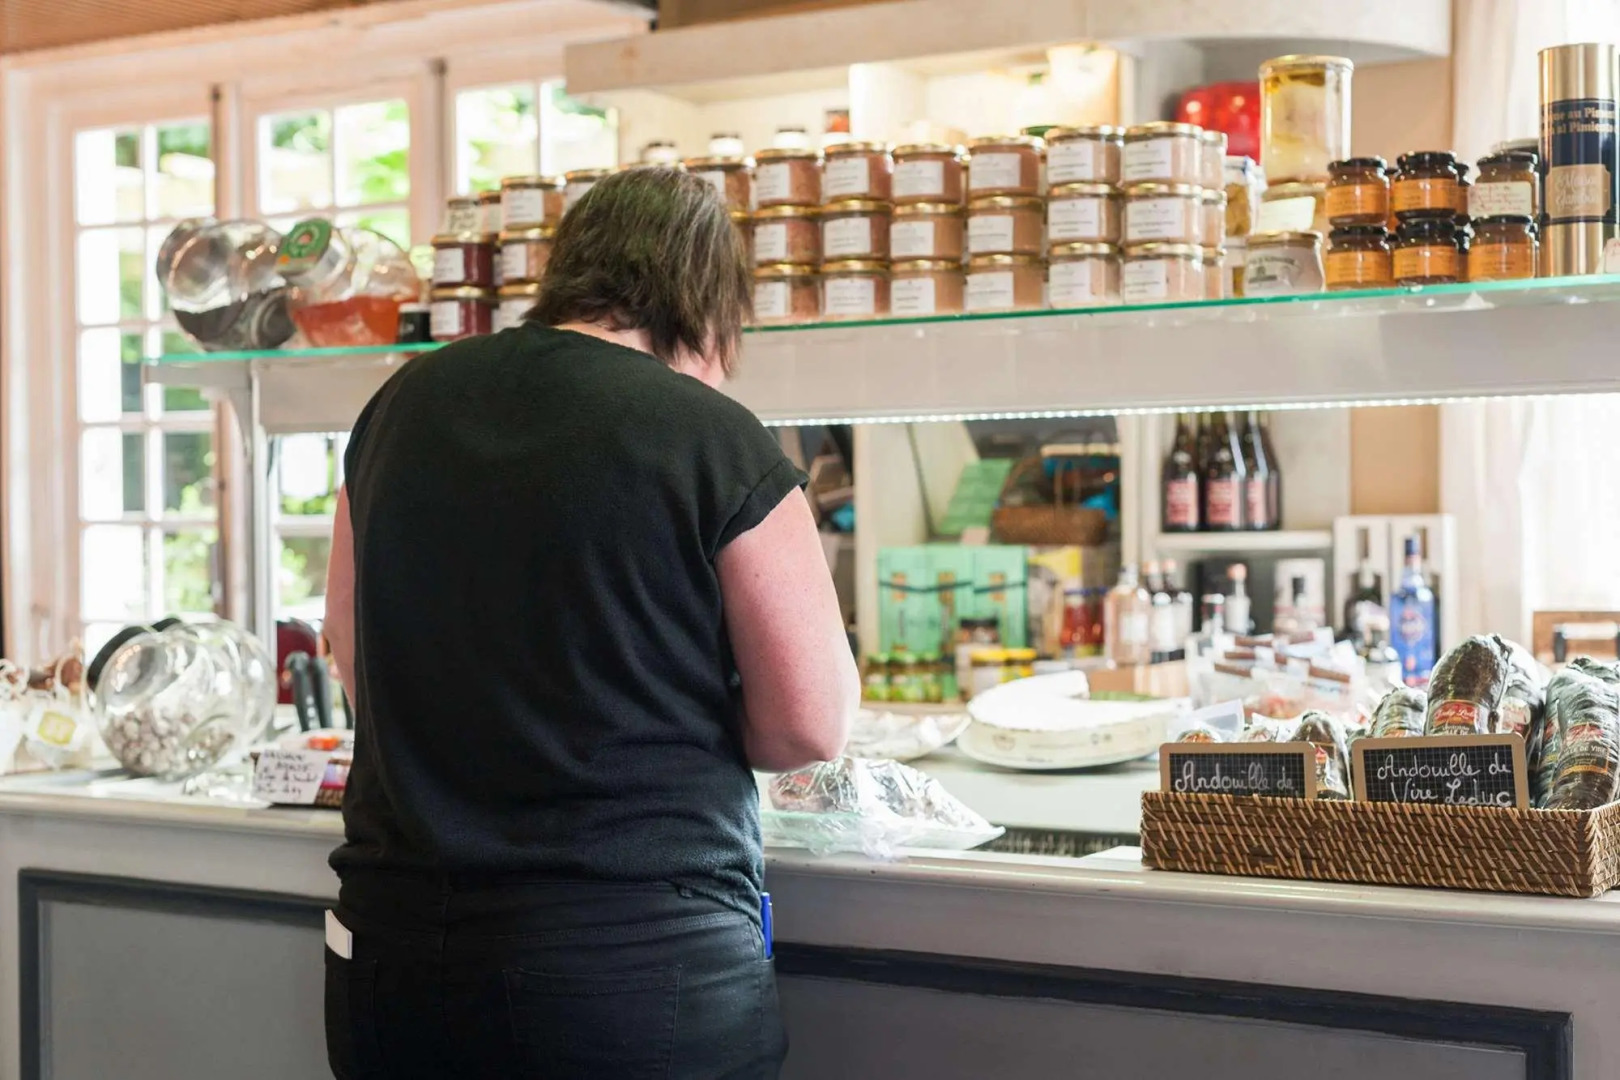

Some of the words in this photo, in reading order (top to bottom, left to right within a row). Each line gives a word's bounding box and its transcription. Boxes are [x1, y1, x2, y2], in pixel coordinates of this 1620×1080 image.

[1175, 760, 1270, 792] Andouille
[1276, 766, 1294, 790] de
[1377, 752, 1480, 780] Andouille
[1390, 778, 1438, 803] Vire
